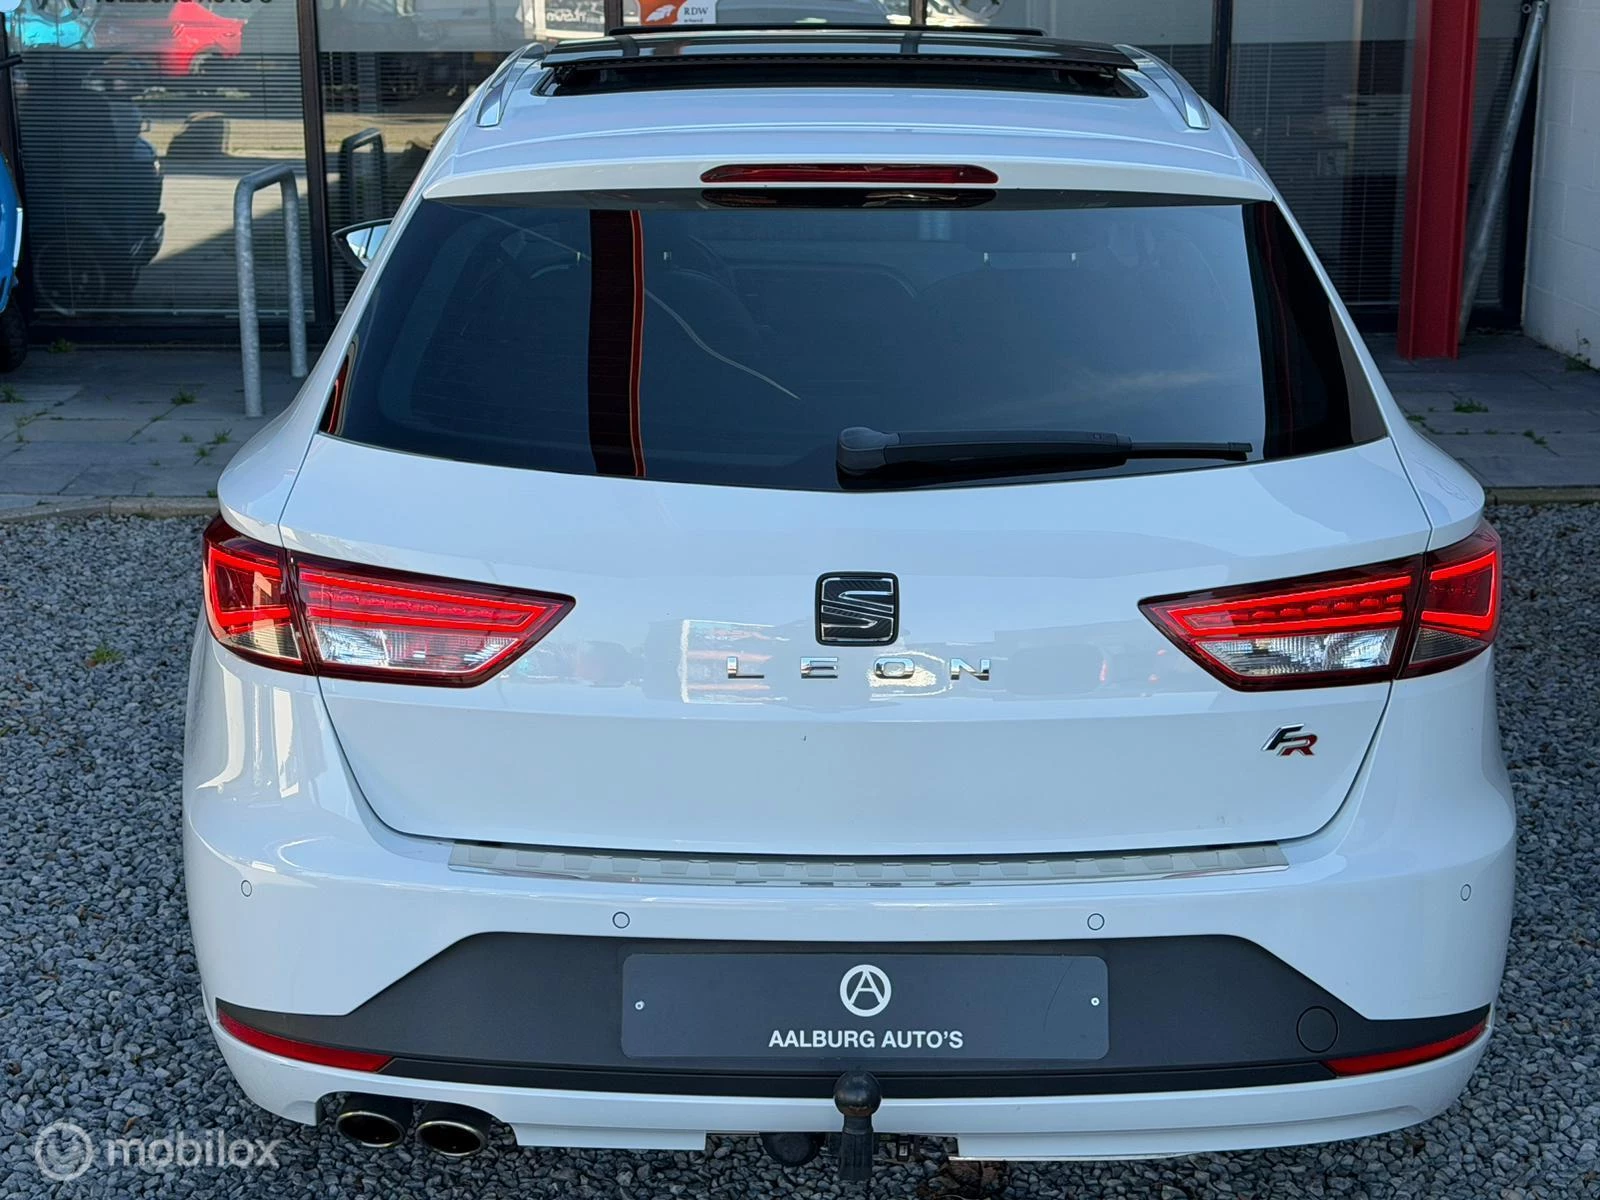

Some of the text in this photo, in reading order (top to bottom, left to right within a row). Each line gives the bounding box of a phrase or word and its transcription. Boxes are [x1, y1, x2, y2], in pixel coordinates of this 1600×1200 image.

[684, 7, 709, 15] RDW
[727, 656, 992, 681] LEON
[1261, 723, 1318, 756] FR
[768, 1030, 964, 1049] AALBURG AUTO'S
